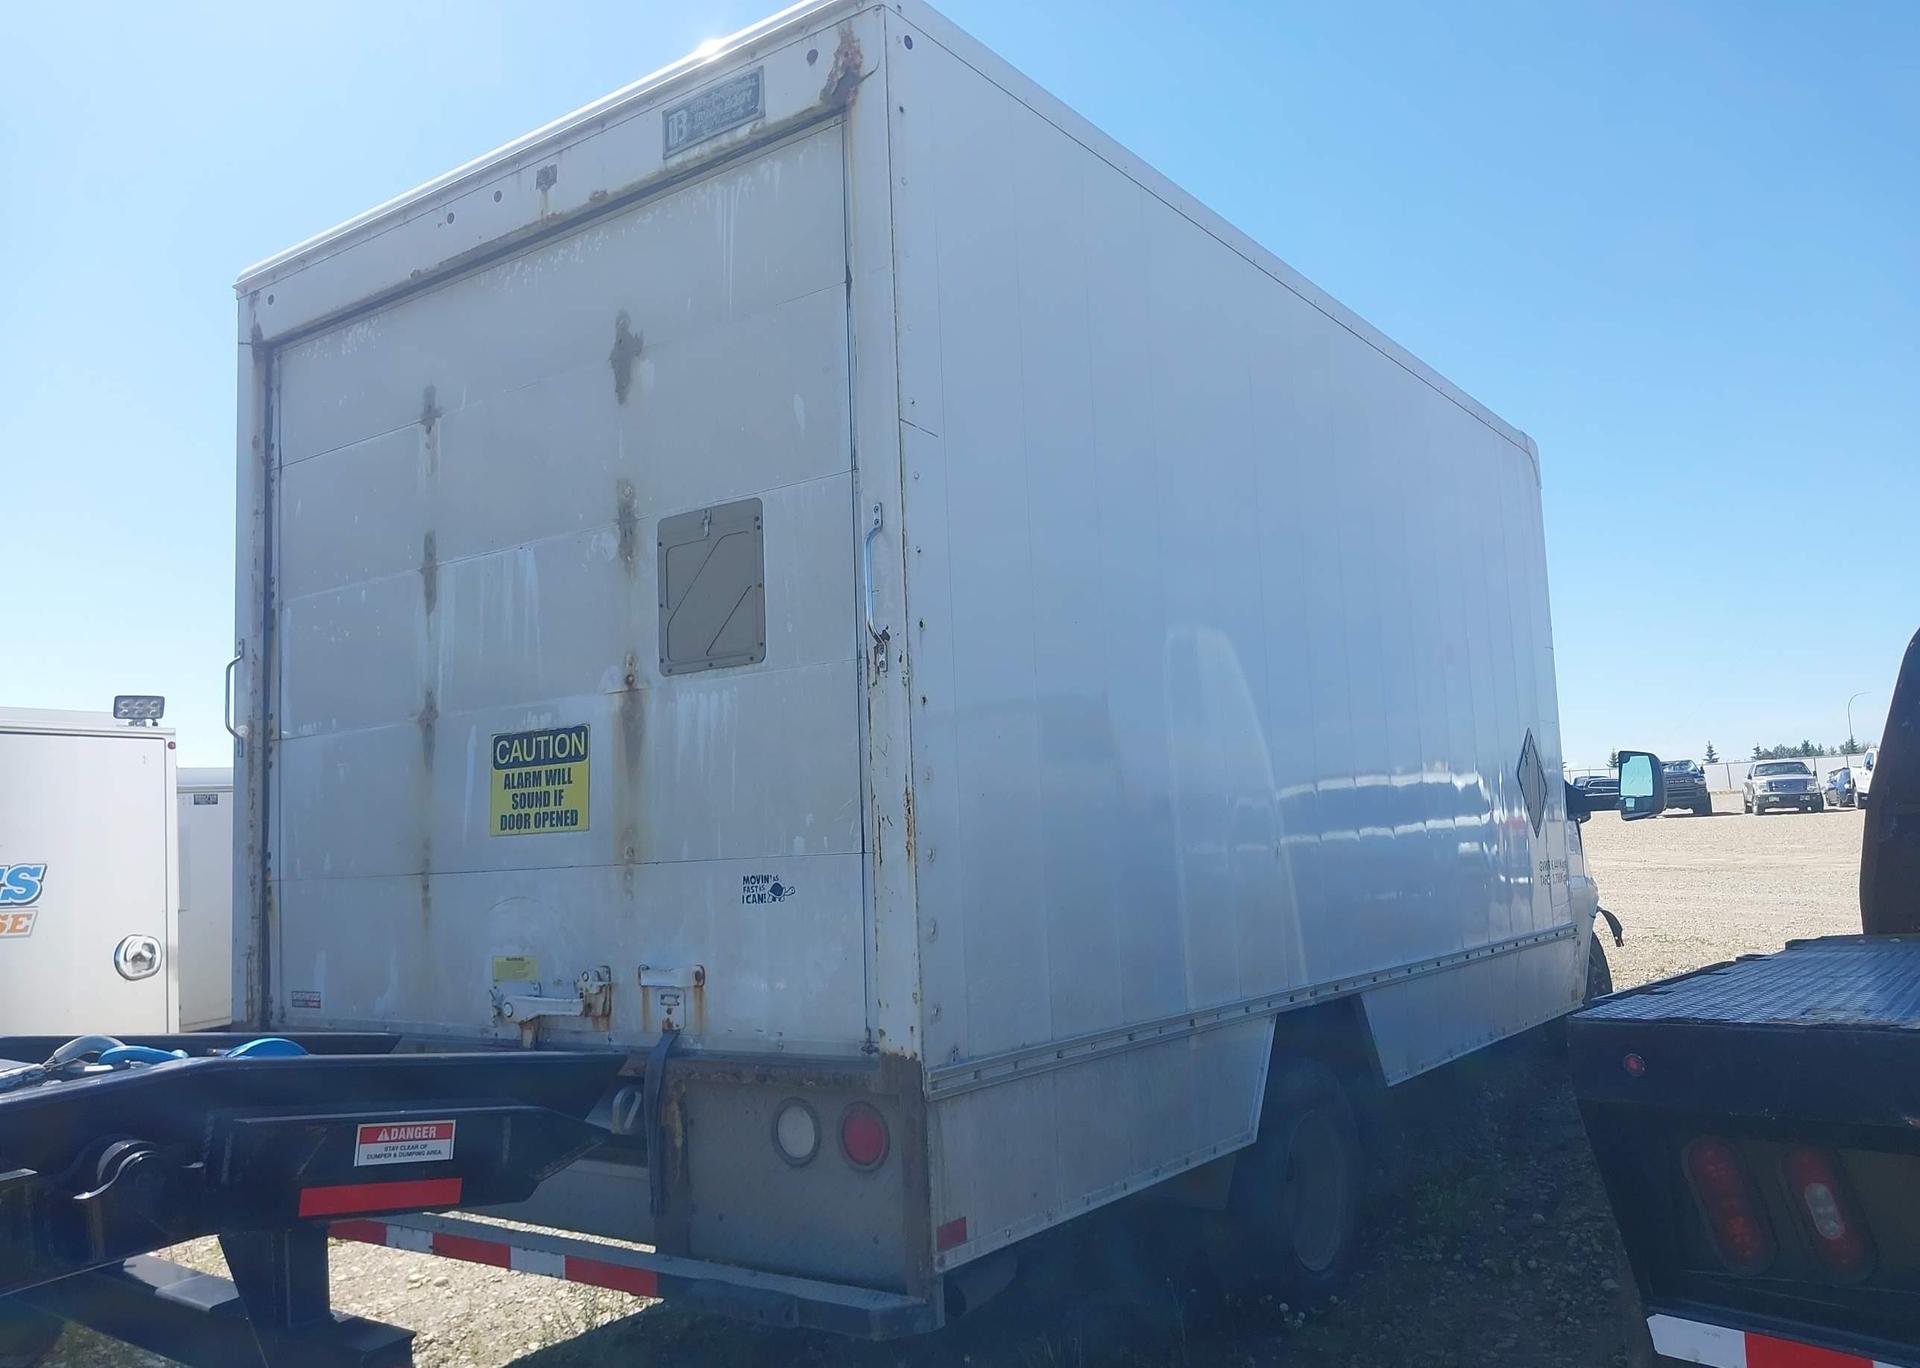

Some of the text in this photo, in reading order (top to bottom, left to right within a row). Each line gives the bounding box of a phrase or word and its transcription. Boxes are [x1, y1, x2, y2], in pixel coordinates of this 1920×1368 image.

[496, 731, 585, 764] CAUTION
[504, 767, 573, 790] ALARM WILL
[511, 789, 564, 810] SOUND IF
[500, 809, 578, 831] DOOR OPENED
[0, 863, 47, 906] S
[743, 885, 758, 894] FAST
[741, 893, 766, 904] I CAN!
[390, 1126, 437, 1140] DANGER
[366, 1152, 391, 1160] DUMPER
